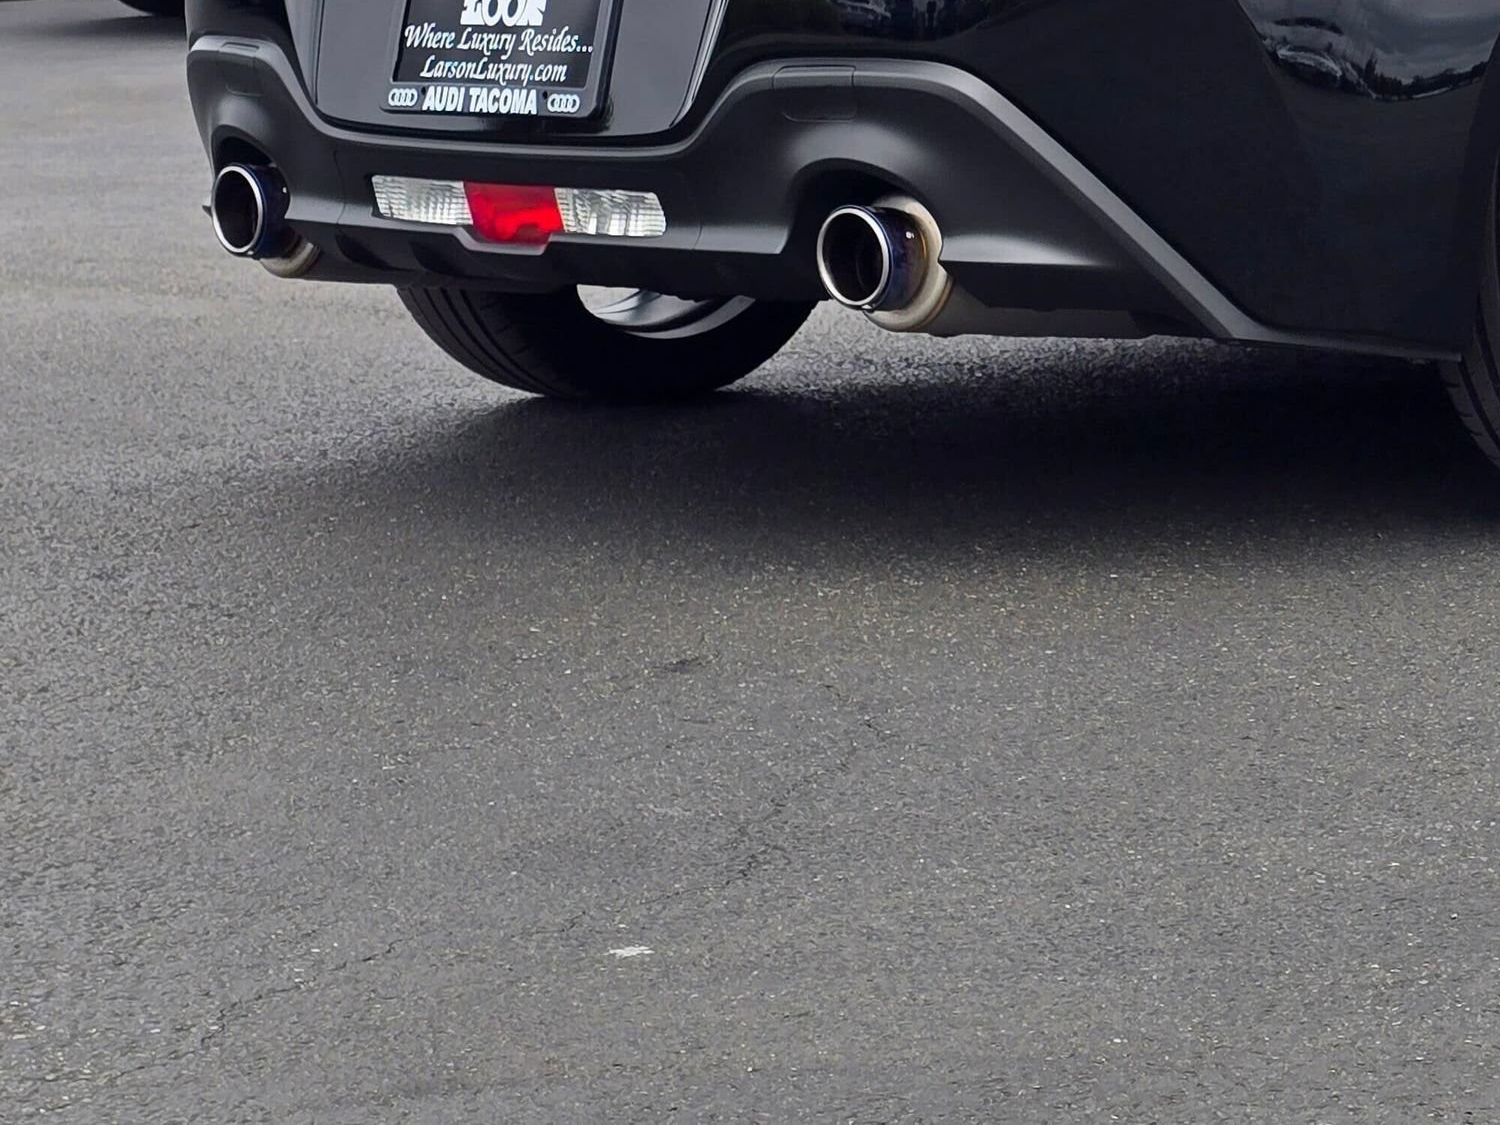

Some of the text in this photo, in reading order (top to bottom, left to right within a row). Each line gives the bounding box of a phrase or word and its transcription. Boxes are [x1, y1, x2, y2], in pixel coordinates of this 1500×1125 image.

[404, 23, 593, 58] Where Luxury Resides...
[419, 55, 568, 87] LarsonLuxury.com
[422, 86, 538, 115] AUDI TACOMA
